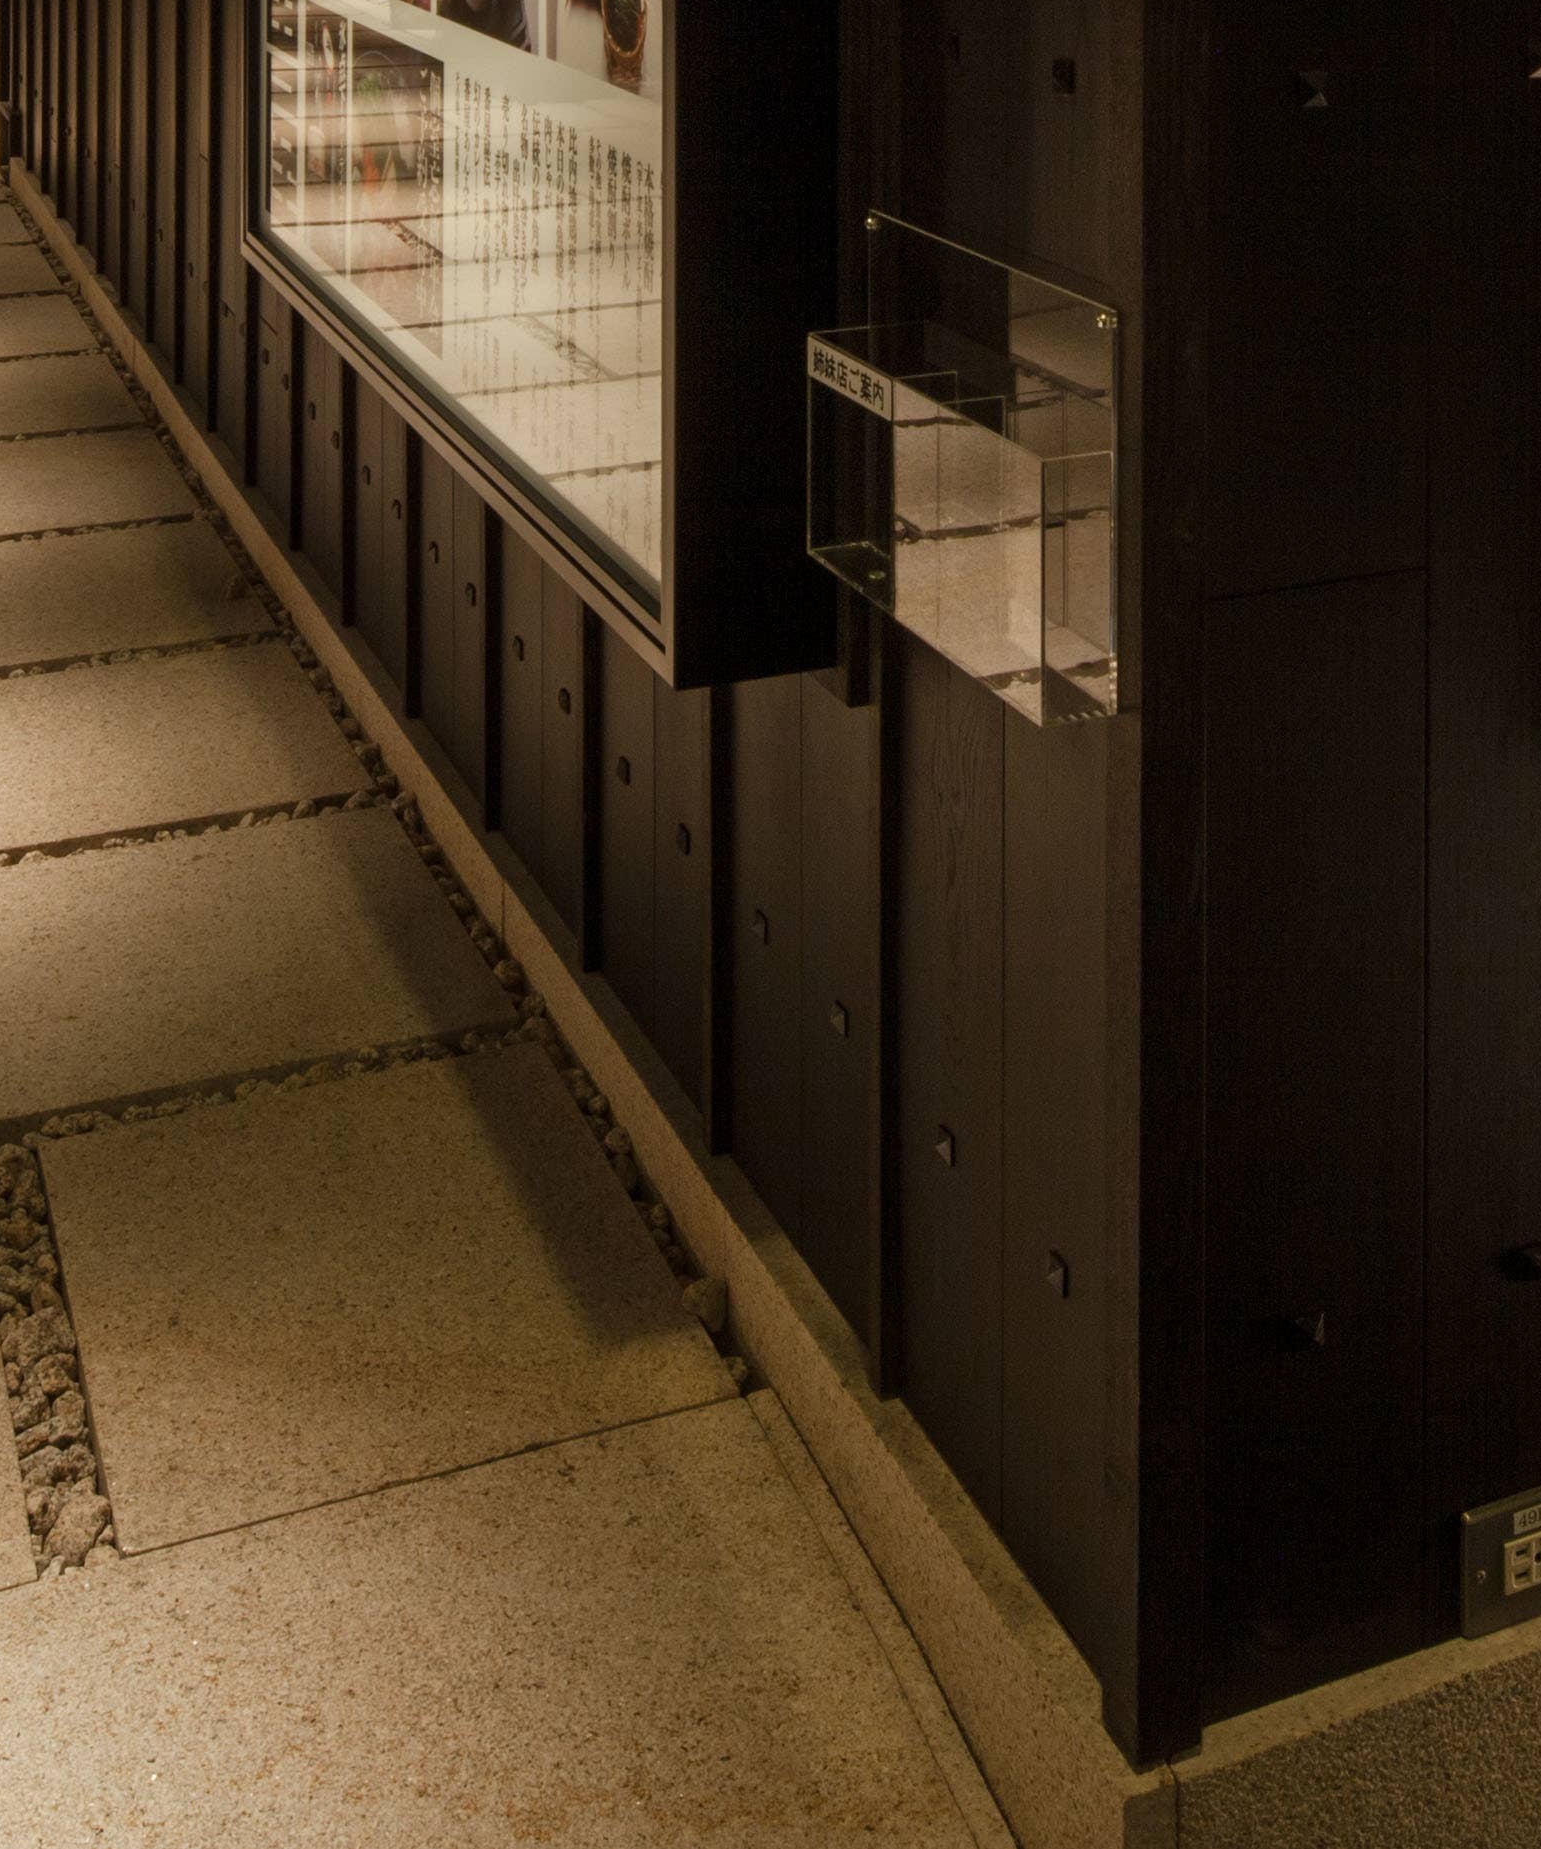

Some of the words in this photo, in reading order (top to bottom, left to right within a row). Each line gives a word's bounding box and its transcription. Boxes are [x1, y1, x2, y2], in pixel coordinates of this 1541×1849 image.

[813, 346, 885, 412] 姉妹店ご案内
